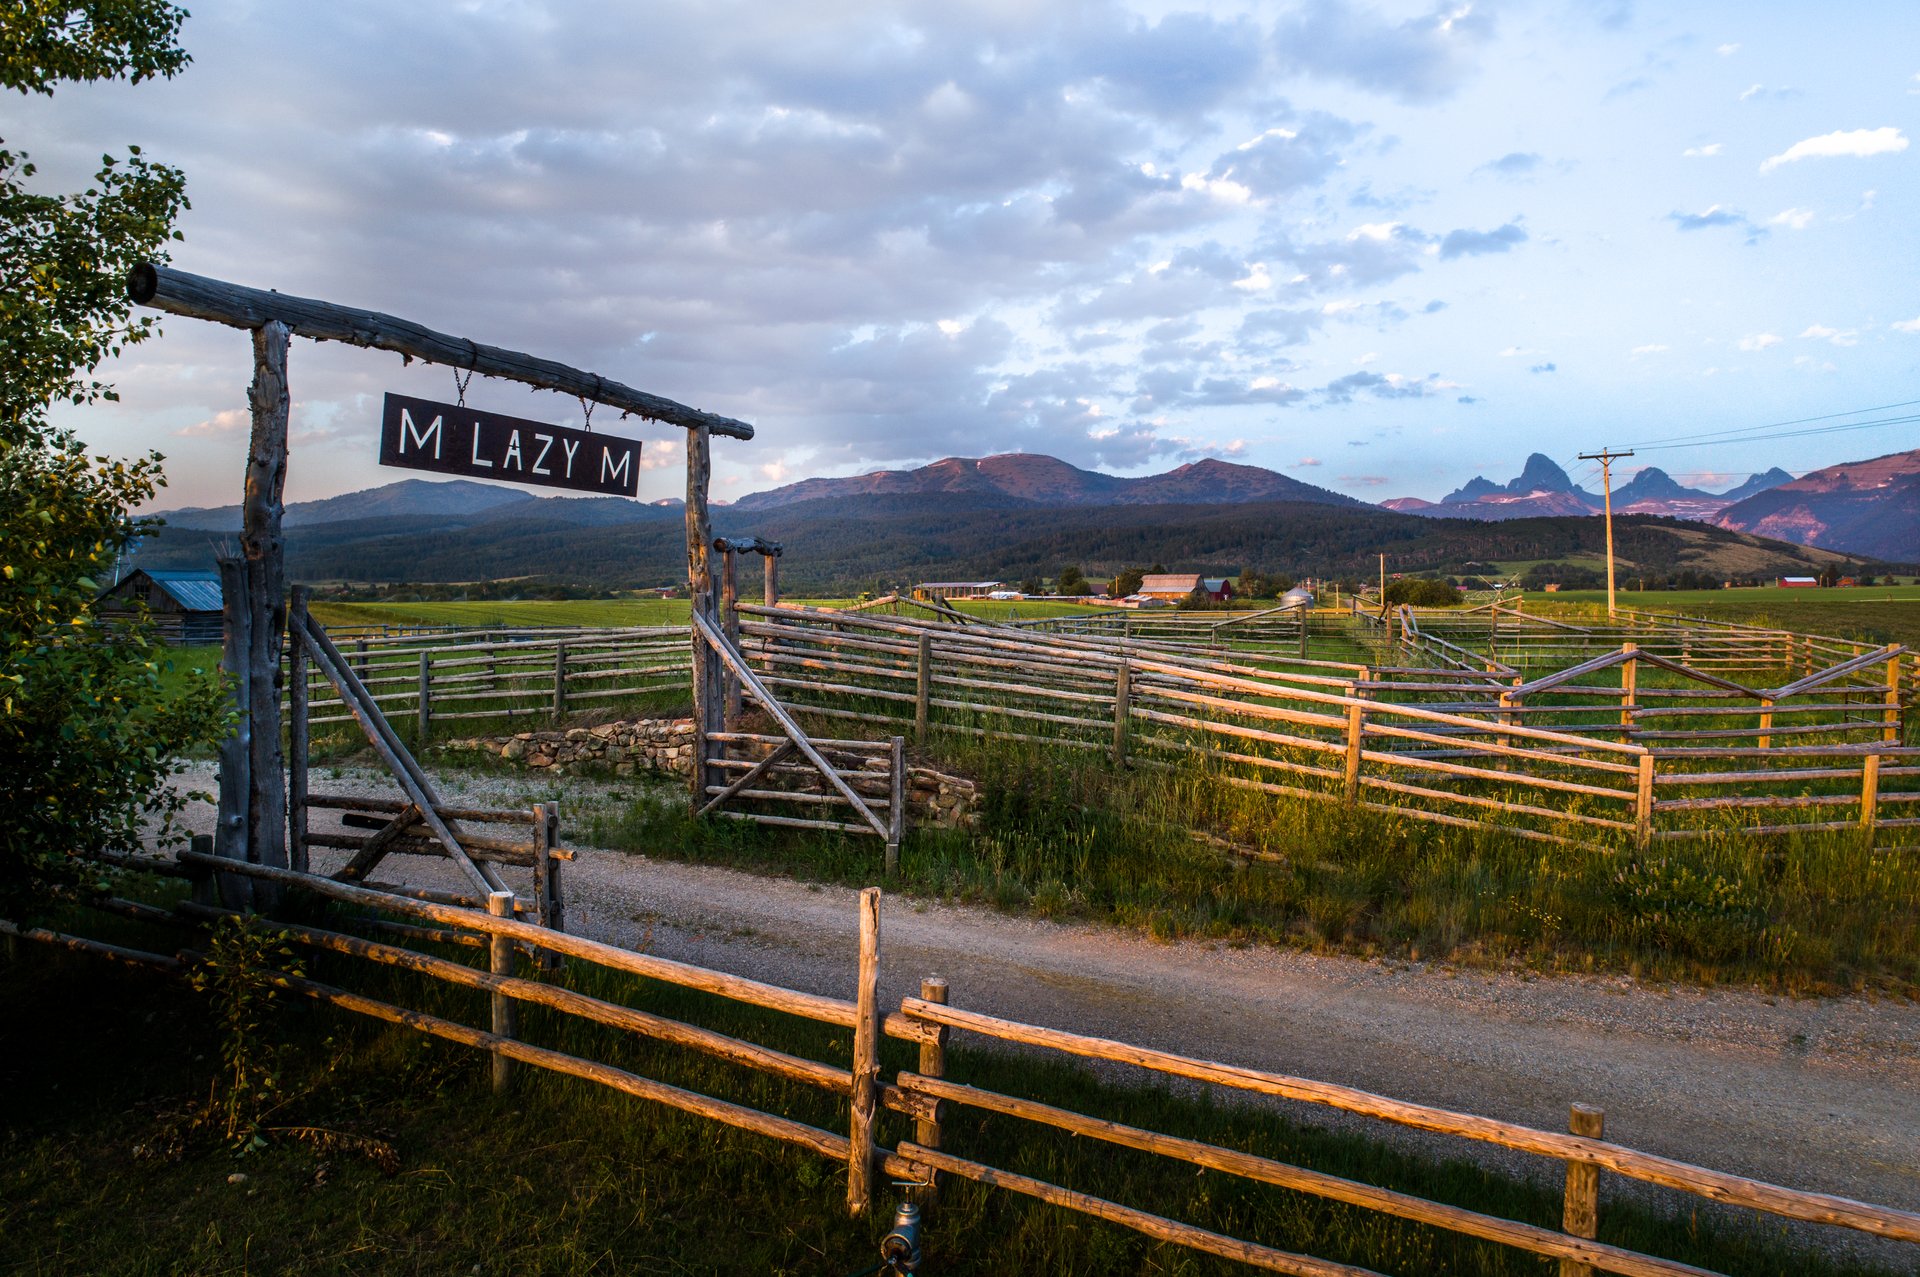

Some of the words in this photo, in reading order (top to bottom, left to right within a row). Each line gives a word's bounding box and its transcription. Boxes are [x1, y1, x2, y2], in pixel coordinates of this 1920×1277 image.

[399, 408, 443, 460] M
[472, 422, 580, 479] LAZY
[600, 446, 631, 487] M
